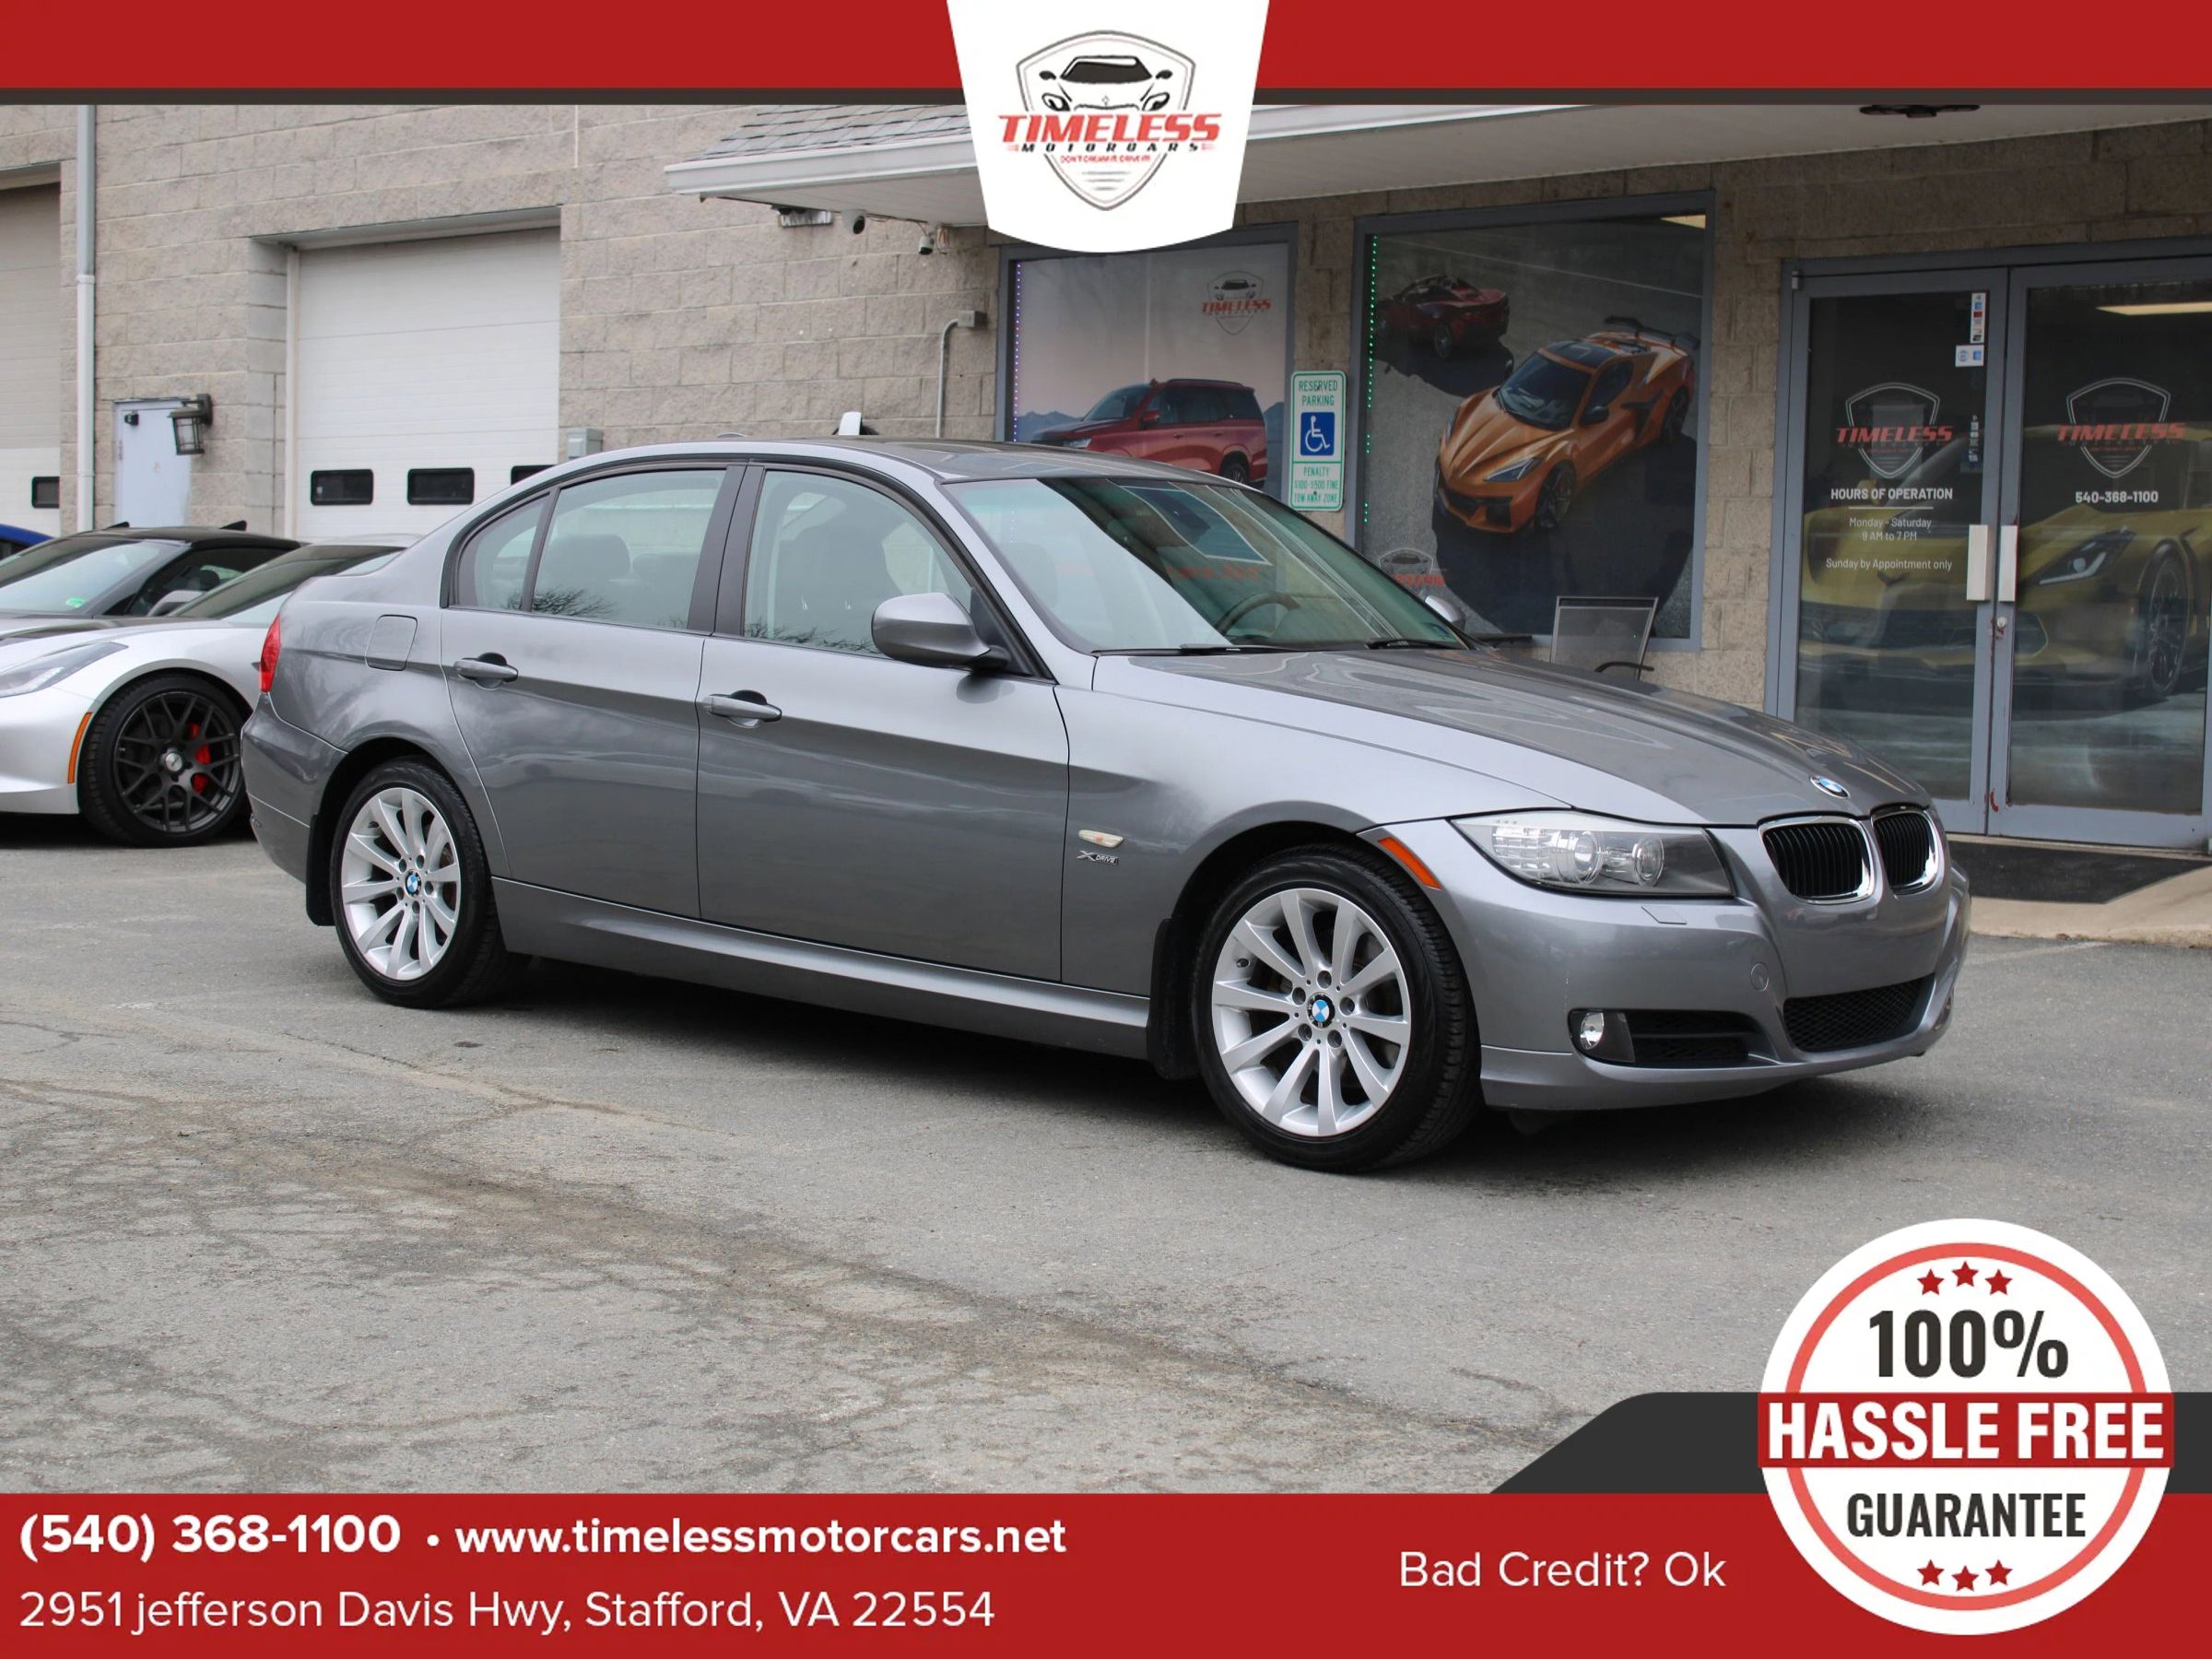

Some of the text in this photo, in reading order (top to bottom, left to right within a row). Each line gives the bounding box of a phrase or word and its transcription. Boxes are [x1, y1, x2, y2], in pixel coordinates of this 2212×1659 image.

[1299, 380, 1338, 392] RESERVED
[1301, 394, 1335, 406] PARKING
[1837, 426, 1953, 442] TIMELESS
[2058, 423, 2185, 441] TIMELESS
[1303, 466, 1330, 477] PENALTY
[1294, 492, 1337, 503] TOW AWAY ZONE
[1830, 488, 1953, 500] HOURS OF OPERATION
[2075, 490, 2159, 503] 540-368-1100
[1849, 517, 1886, 530] Monday
[1890, 517, 1932, 530] Saturday
[1862, 531, 1917, 541] 9 AM to 7 PM
[1826, 557, 1953, 571] Sunday by Appointment only
